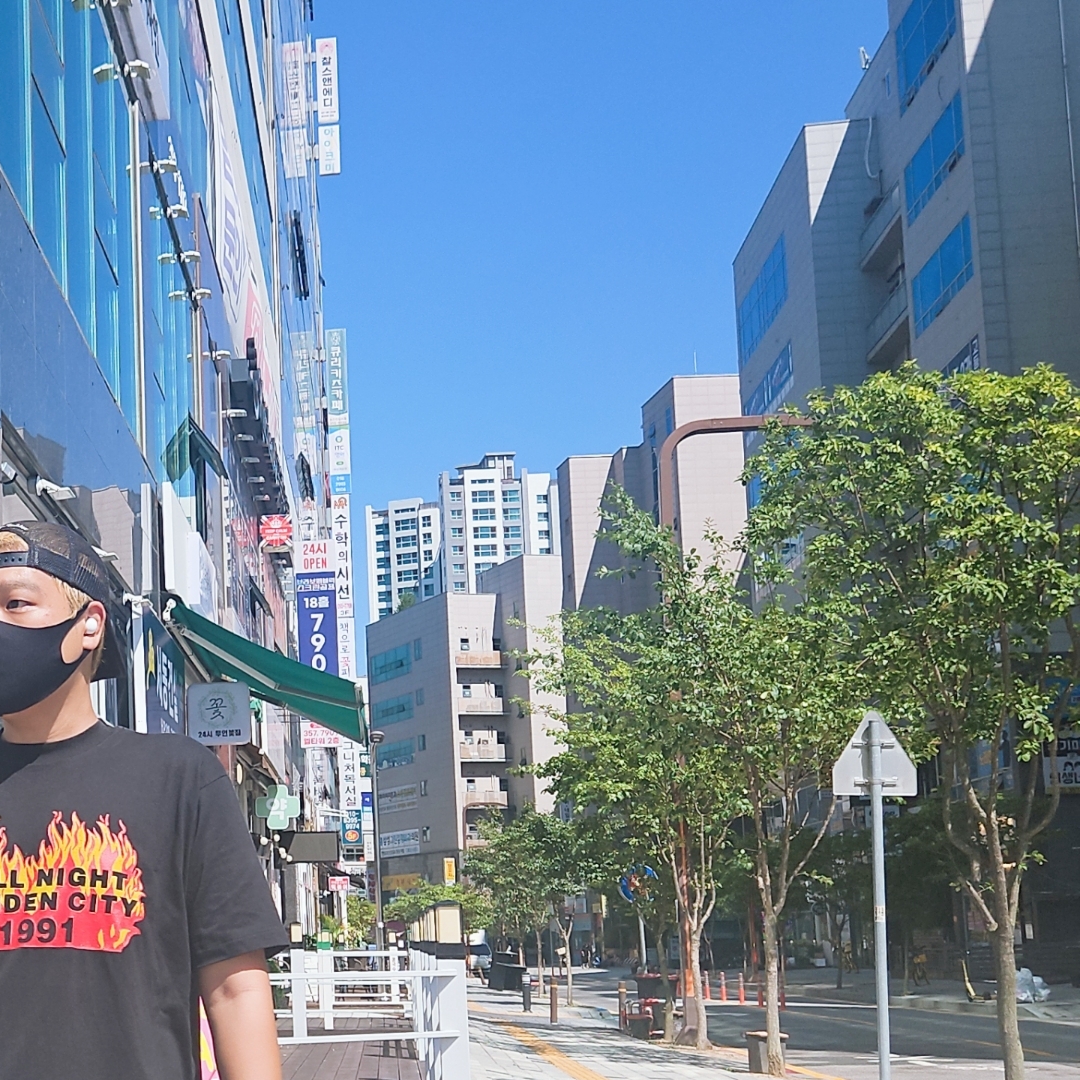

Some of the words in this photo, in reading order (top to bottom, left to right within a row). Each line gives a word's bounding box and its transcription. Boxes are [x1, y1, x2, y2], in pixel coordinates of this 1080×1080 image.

[303, 542, 327, 556] 24시
[303, 557, 327, 570] OPEN
[205, 697, 227, 720] 꽃
[265, 798, 288, 820] 약
[36, 867, 128, 891] NIGHT
[69, 891, 139, 918] CITY
[0, 917, 75, 945] 1991
